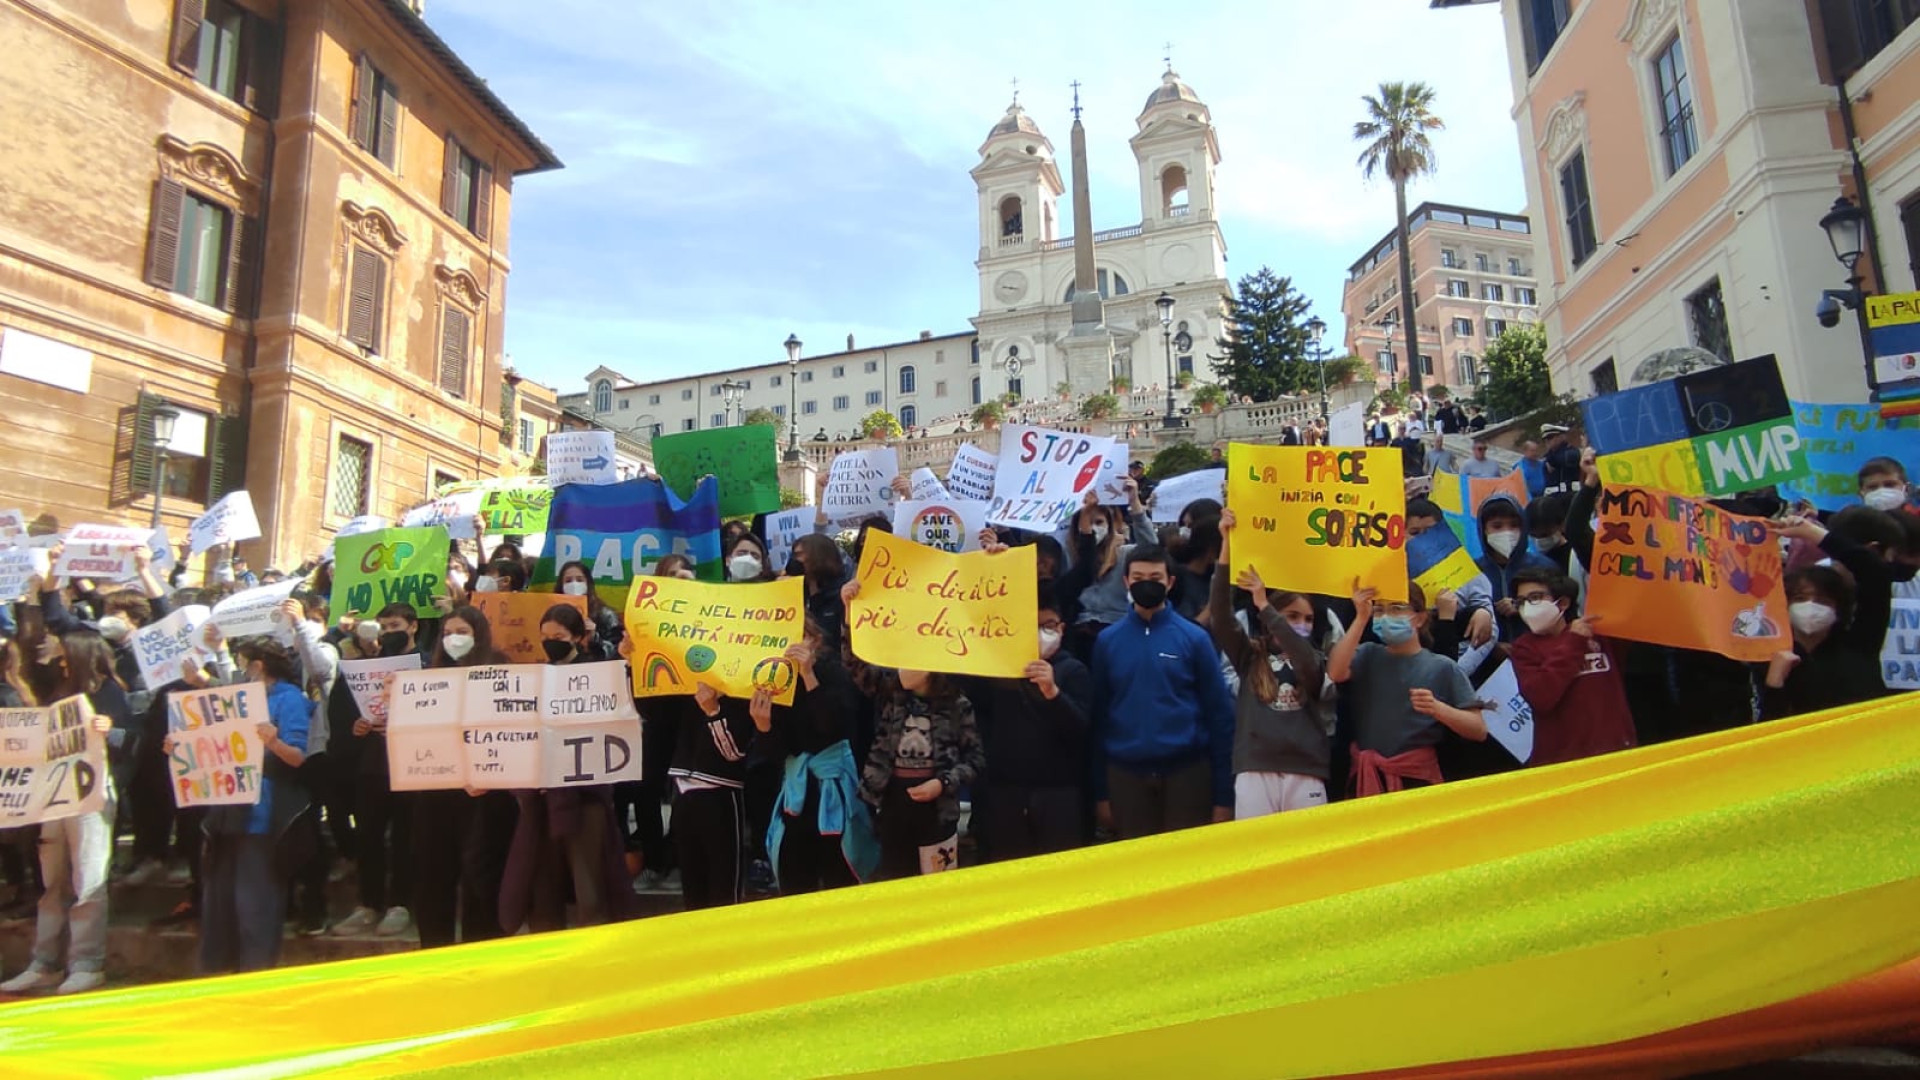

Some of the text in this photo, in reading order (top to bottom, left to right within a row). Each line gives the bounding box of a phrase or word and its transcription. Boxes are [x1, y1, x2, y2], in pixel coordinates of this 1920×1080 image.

[1020, 431, 1091, 465] STOP
[1706, 425, 1800, 489] МИР
[833, 458, 868, 470] FATE LA
[858, 470, 884, 480] NON
[971, 469, 995, 481] VIRUS
[1249, 450, 1370, 484] LA PACE
[828, 483, 871, 494] FATE LA
[1021, 470, 1048, 494] AL
[827, 496, 872, 505] GUERRA
[985, 496, 1077, 524] PAZZISMO
[1336, 492, 1360, 506] CON
[778, 515, 800, 531] VIVA
[922, 515, 953, 525] SAVE
[1253, 501, 1405, 550] UN SORRISO
[1602, 488, 1767, 545] MANIFESTIAMO
[925, 529, 950, 539] OUR
[1599, 522, 1635, 545] X
[864, 545, 1009, 601] Più diritti
[1598, 552, 1719, 589] NEL MONDO
[346, 573, 438, 614] NO WAR
[634, 580, 797, 621] PACE NEL MONDO
[139, 629, 164, 645] NOI
[633, 622, 649, 638] E
[728, 632, 789, 649] INTORNO
[855, 606, 1019, 656] più dignità
[145, 653, 165, 666] LA
[347, 672, 367, 681] AKE
[493, 681, 509, 693] CON
[568, 675, 590, 691] MA
[403, 683, 416, 695] LA
[550, 693, 618, 715] STIMOLANDO
[463, 729, 538, 744] E LA CULTURA
[172, 730, 248, 776] SIAMO
[416, 749, 434, 761] LA
[564, 734, 631, 782] ID
[43, 758, 96, 803] 2D
